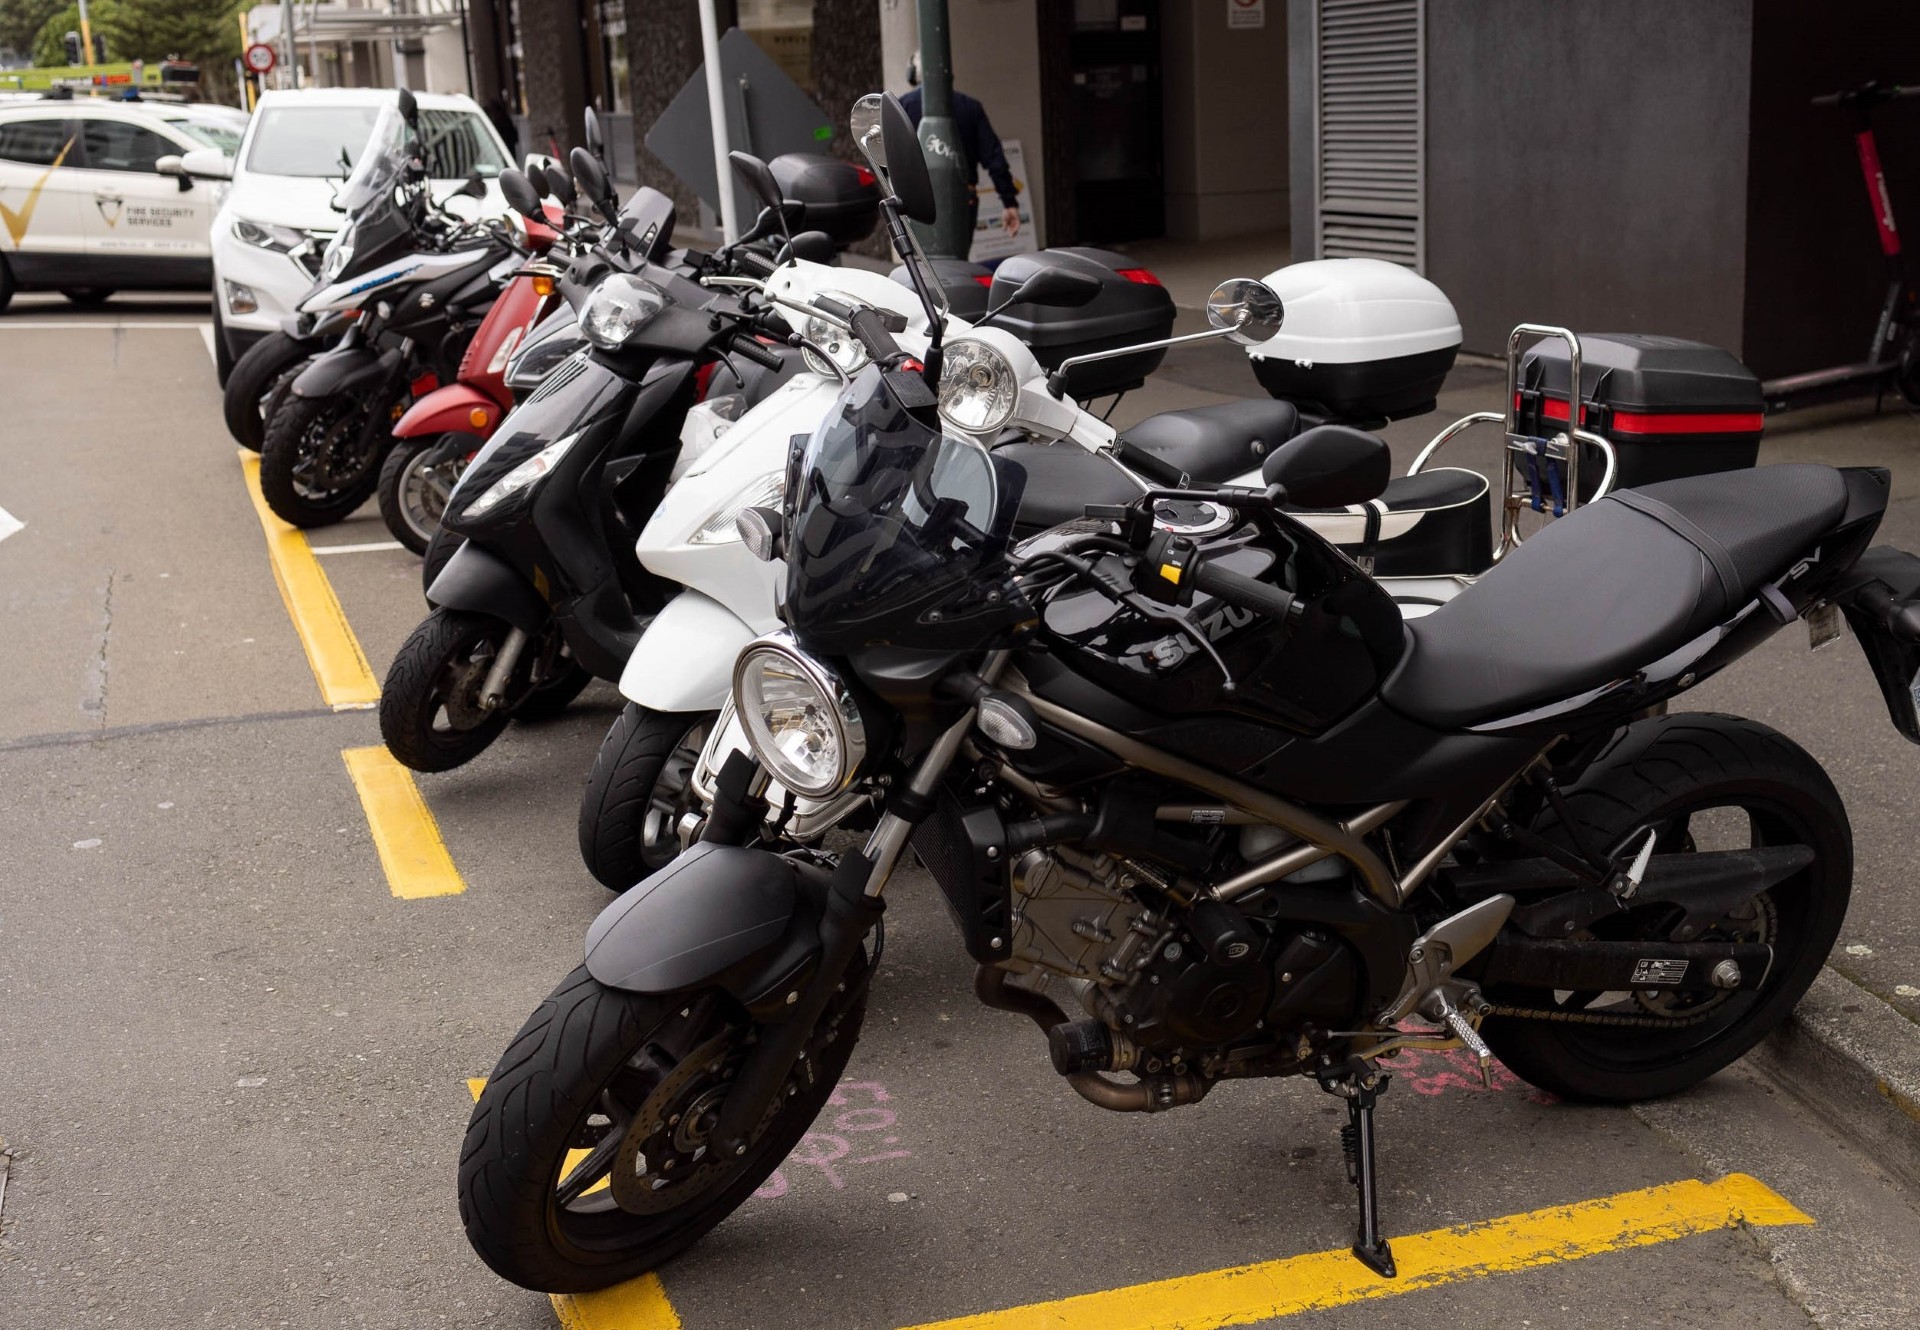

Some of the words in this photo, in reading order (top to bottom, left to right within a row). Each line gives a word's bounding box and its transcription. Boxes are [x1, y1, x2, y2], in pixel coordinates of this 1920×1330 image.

[127, 207, 146, 215] FIRE
[150, 207, 194, 217] SECURITY
[127, 217, 172, 227] SERVICES
